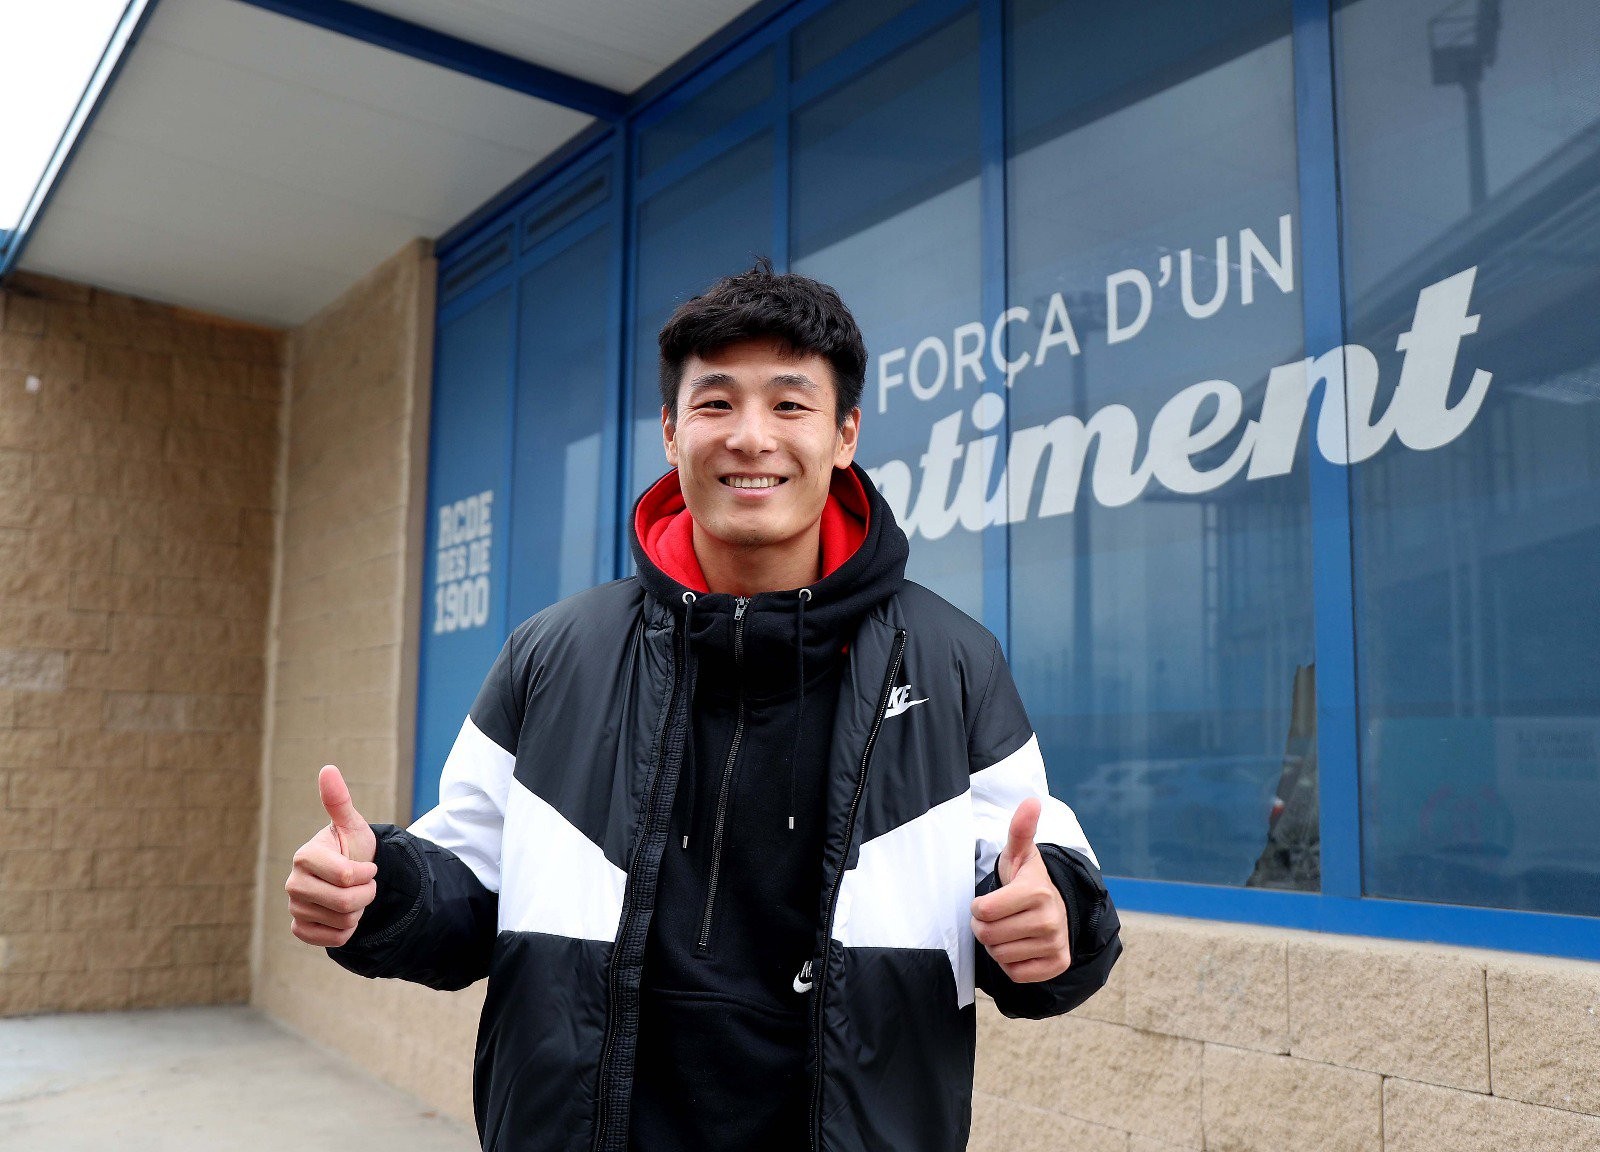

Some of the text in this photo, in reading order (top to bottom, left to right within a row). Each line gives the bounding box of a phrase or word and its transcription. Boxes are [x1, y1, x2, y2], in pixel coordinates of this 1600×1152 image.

[878, 291, 1081, 414] FORÇA
[866, 265, 1493, 541] ntiment
[434, 575, 490, 634] 1900
[887, 684, 912, 710] KE
